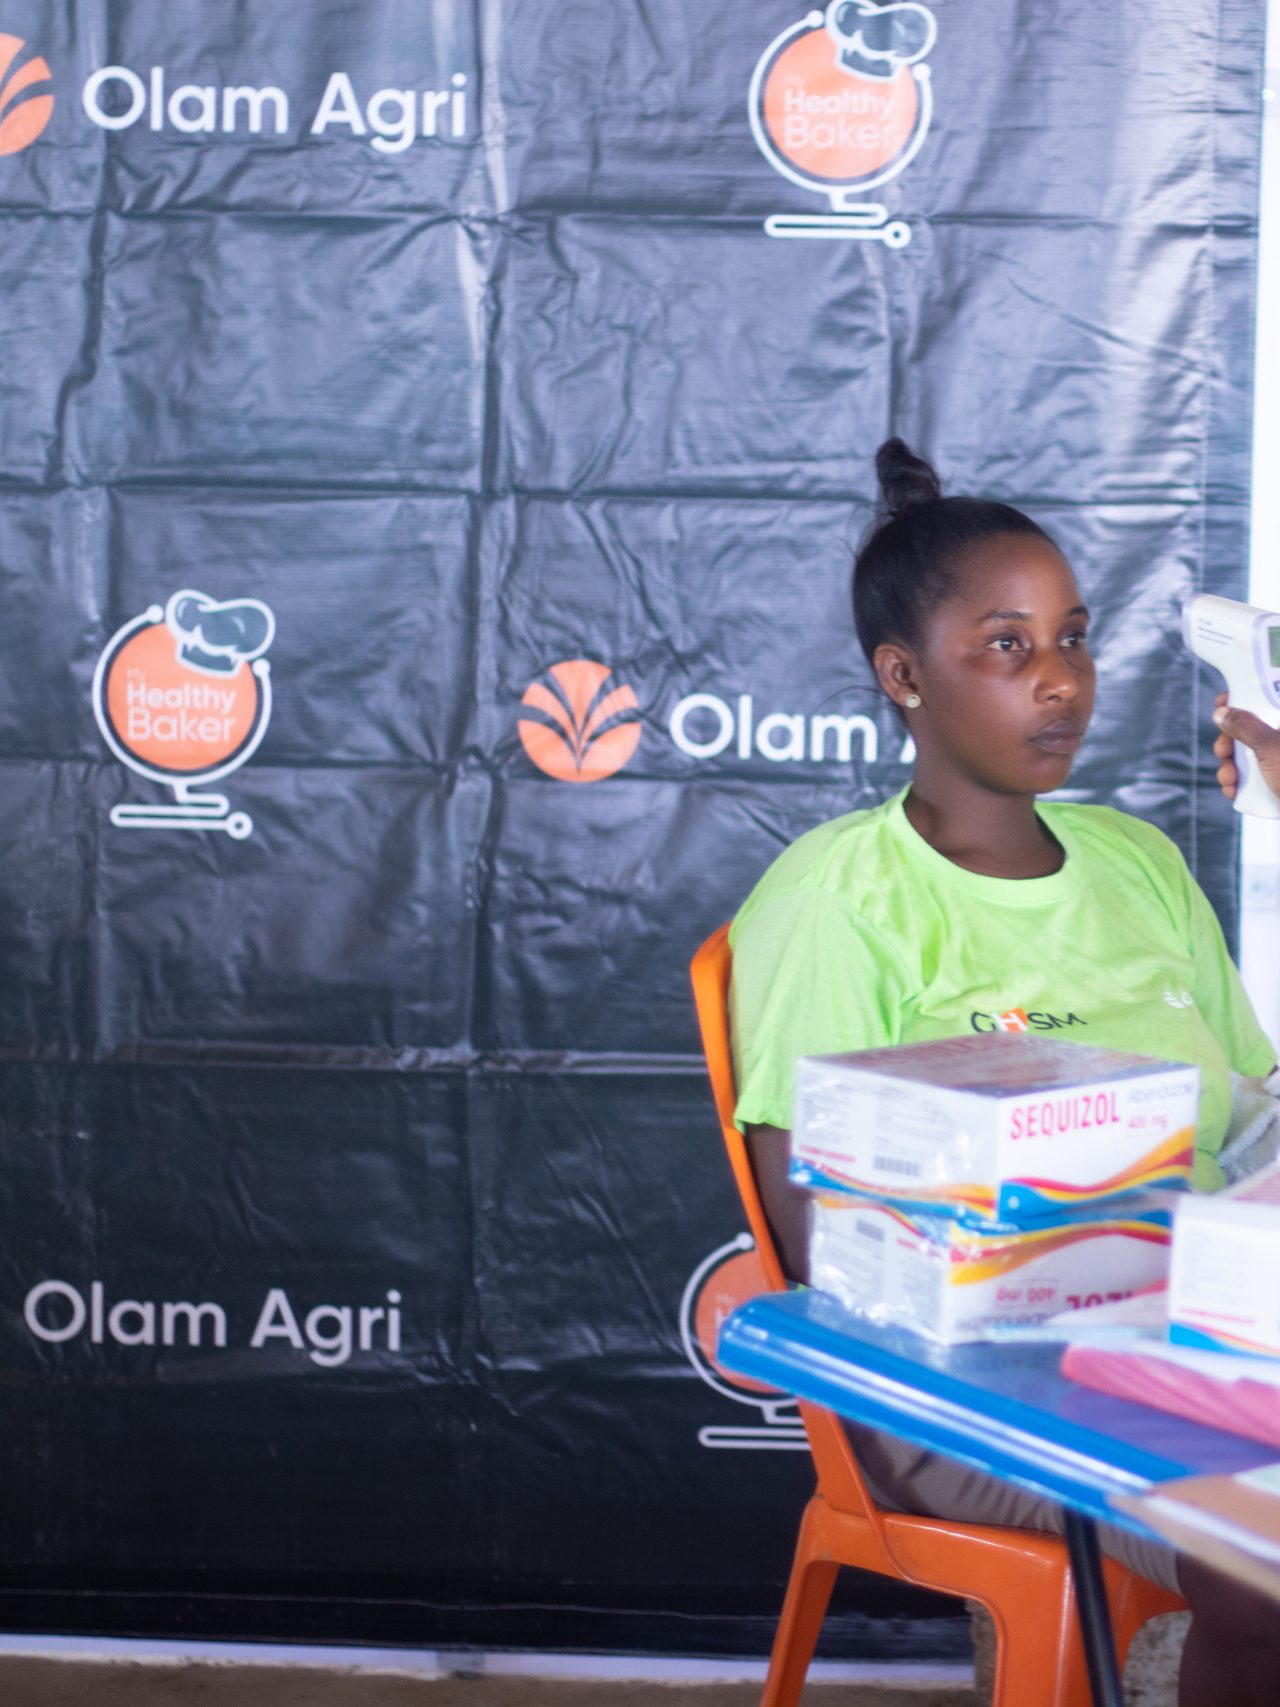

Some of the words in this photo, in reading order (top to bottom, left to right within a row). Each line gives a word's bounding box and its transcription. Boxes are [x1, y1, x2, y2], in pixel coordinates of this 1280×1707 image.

[82, 65, 289, 133] Olam
[310, 72, 467, 153] Agri
[783, 88, 897, 120] Healthy
[784, 114, 897, 149] Baker
[126, 681, 237, 715] Healthy
[127, 706, 236, 743] Baker
[669, 693, 878, 763] Olam
[1010, 1091, 1121, 1140] SEQUIZOL
[24, 1280, 227, 1347] Olam
[250, 1288, 402, 1367] Agri
